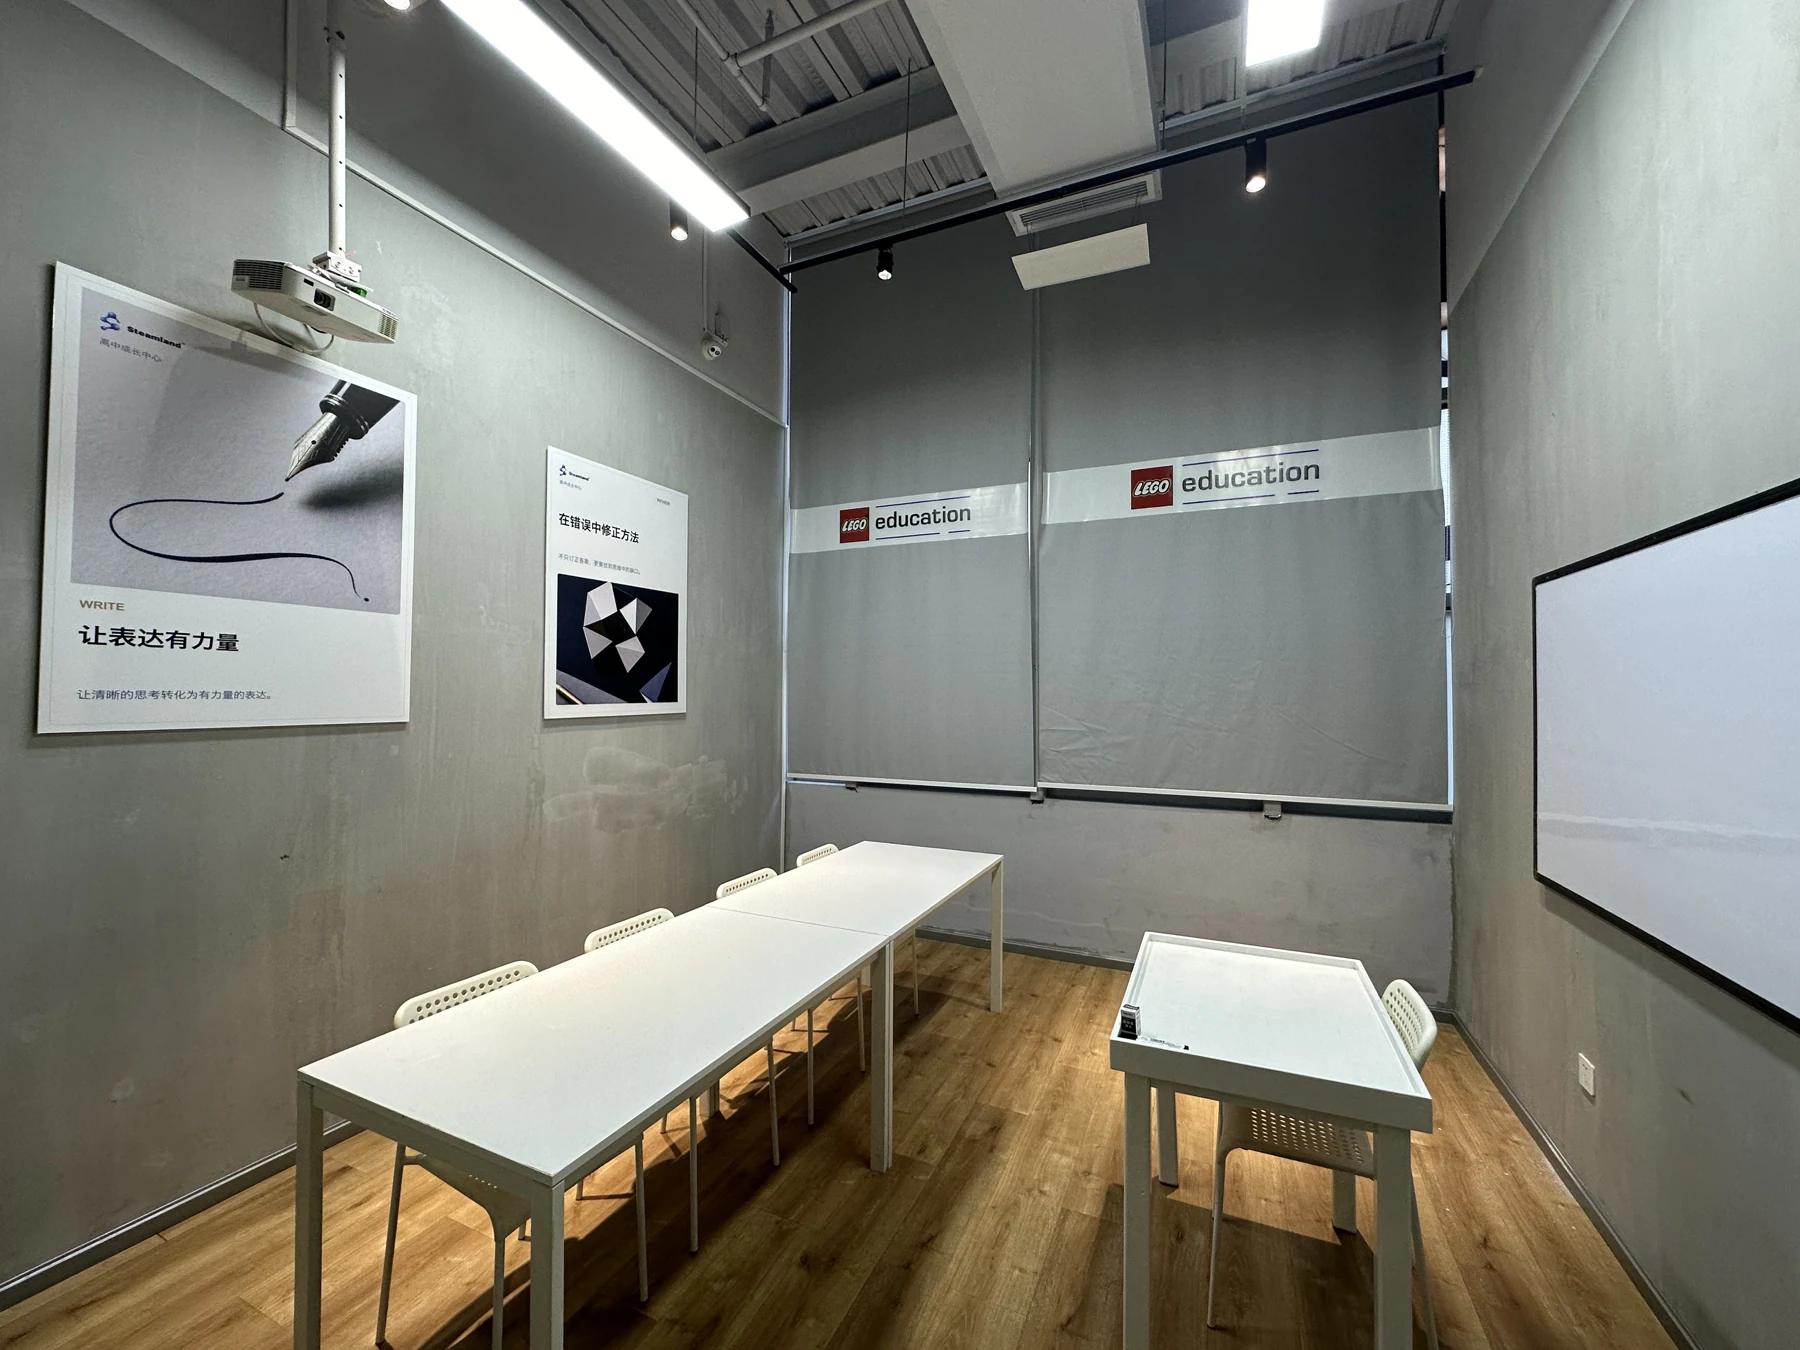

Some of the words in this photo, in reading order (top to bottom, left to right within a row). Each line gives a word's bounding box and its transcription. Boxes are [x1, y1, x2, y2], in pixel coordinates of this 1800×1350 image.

[100, 337, 161, 363] 高中成长中心
[1132, 479, 1171, 497] LEGO
[1181, 461, 1320, 492] education
[558, 512, 640, 544] 在错误中修正方法
[841, 518, 868, 532] LEGO
[875, 506, 971, 530] education
[79, 599, 125, 612] WRITE
[78, 624, 240, 652] 让表达有力量
